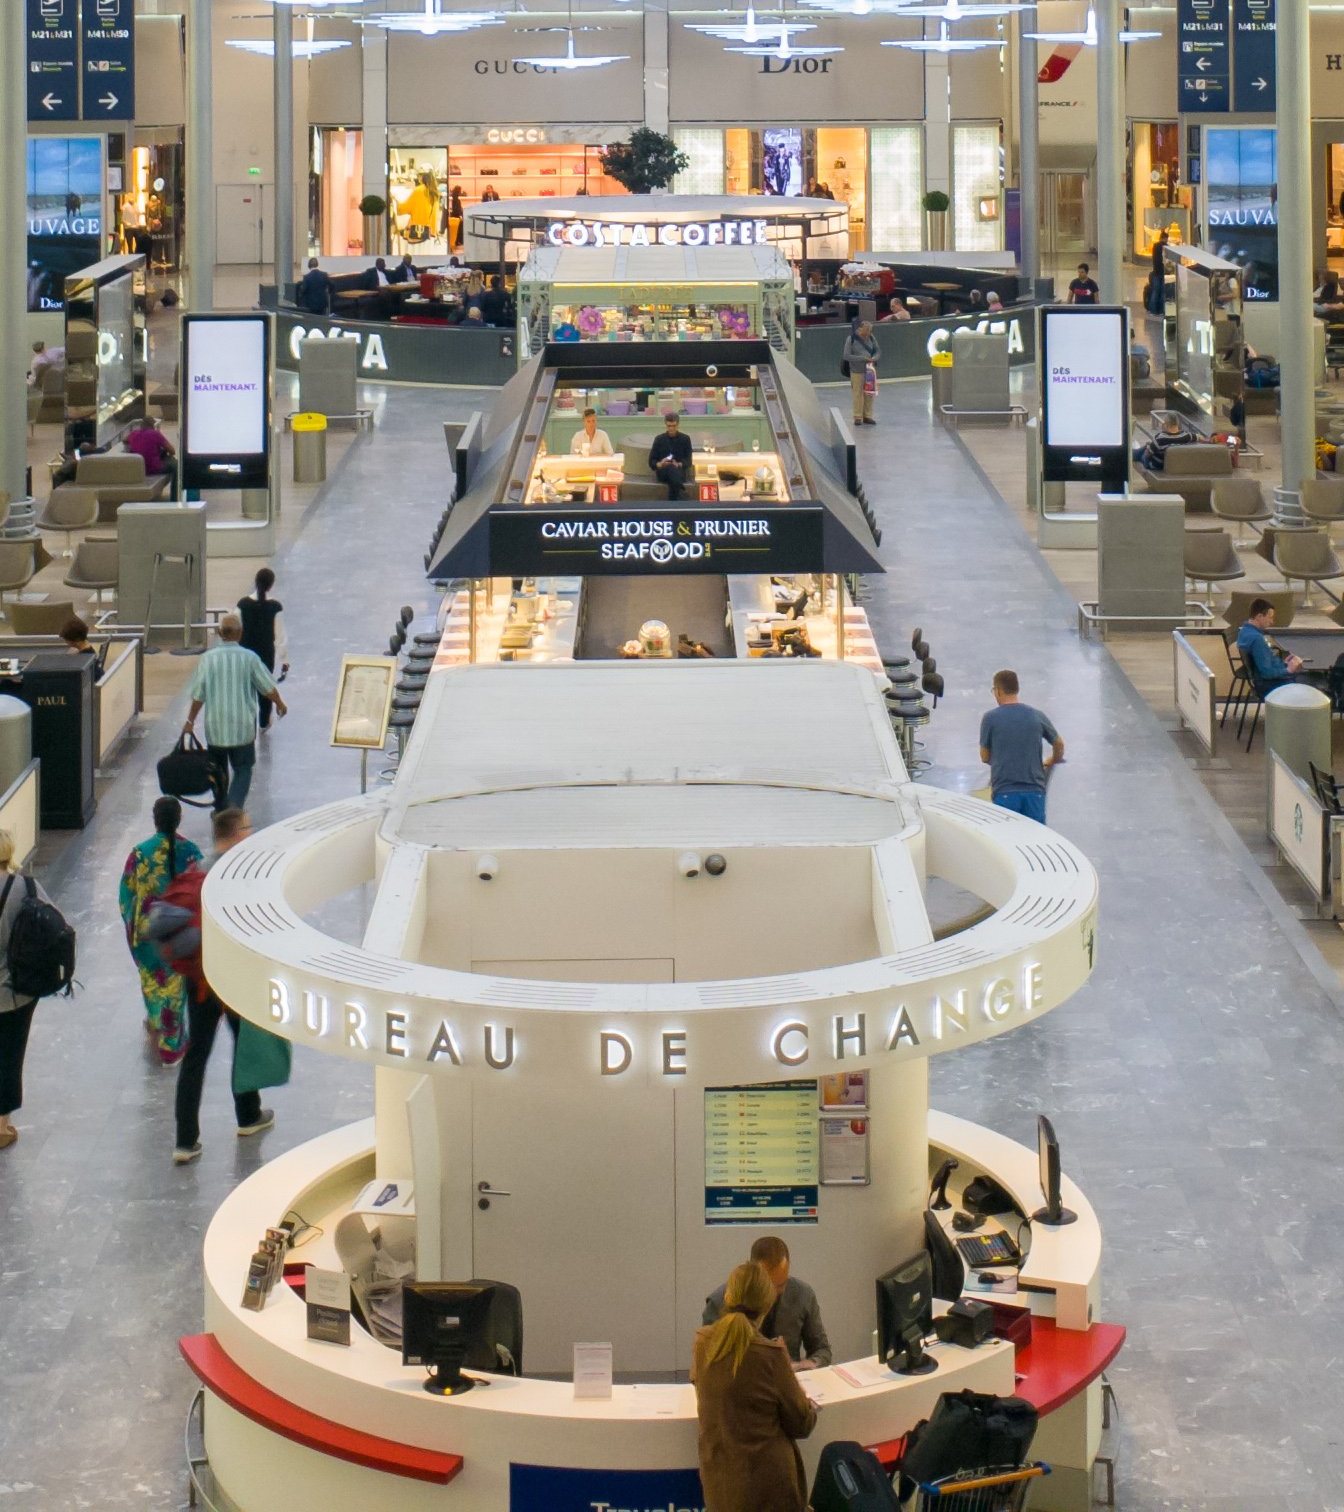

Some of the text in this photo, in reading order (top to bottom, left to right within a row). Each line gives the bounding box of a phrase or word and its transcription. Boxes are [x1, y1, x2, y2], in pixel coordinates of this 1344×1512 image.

[487, 129, 545, 143] GUCCI
[548, 219, 768, 247] COSTA COFFEE
[1247, 287, 1269, 298] Dior
[541, 519, 771, 538] CAVIAR HOUSE & PRUNIER
[267, 961, 1045, 1075] BUREAU DE CHANGE
